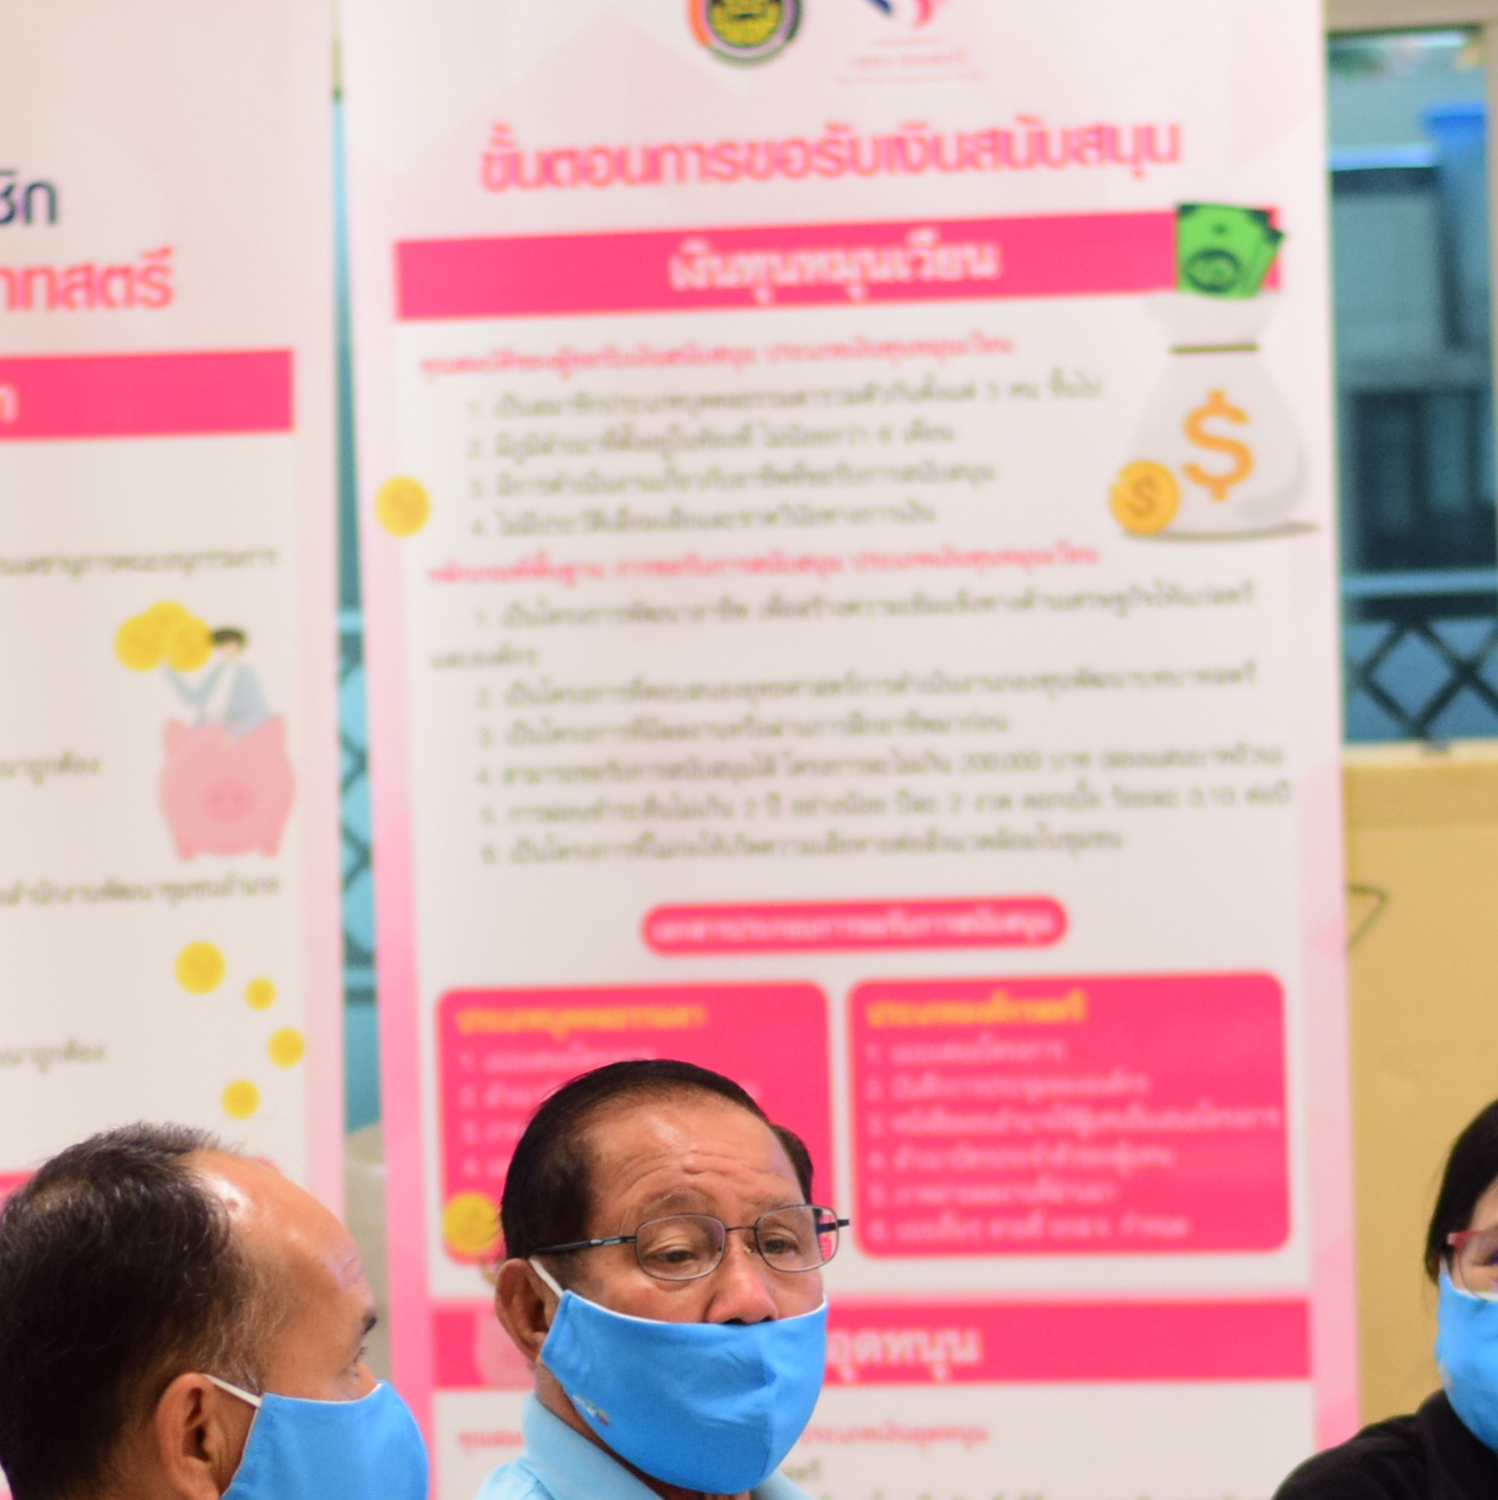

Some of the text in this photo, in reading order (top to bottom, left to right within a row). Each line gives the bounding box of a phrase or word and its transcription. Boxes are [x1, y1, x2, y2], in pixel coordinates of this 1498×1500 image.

[480, 120, 1181, 193] ขั้นตอนการขอรับเงินสนับสนุน
[670, 230, 1001, 304] เงินทุนหมุนเวียน
